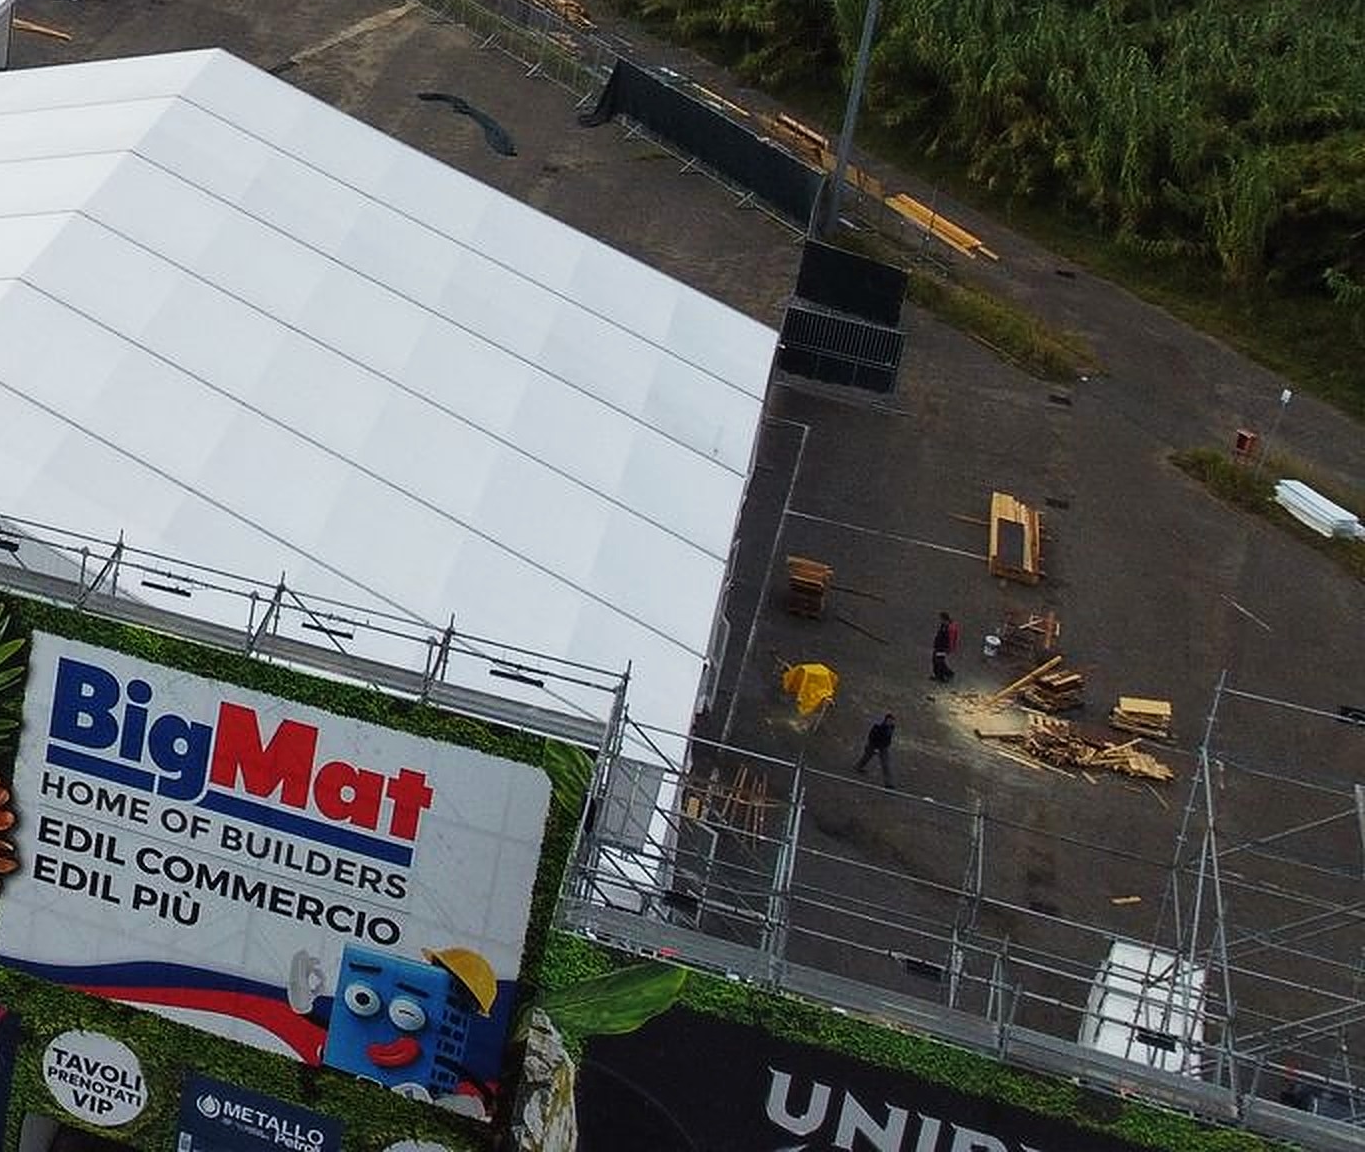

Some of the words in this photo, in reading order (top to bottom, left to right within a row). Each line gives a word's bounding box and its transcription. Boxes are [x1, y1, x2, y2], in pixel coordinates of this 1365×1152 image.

[46, 656, 434, 841] BigMat
[40, 771, 149, 825] HOME
[161, 808, 210, 840] OF
[221, 826, 408, 901] BUILDERS
[33, 852, 121, 905] EDIL
[132, 882, 202, 927] PIÙ
[37, 815, 126, 866] EDIL
[135, 844, 402, 946] COMMERCIO
[46, 1067, 142, 1109] PRENOTATI
[51, 1047, 142, 1091] TAVOLI
[71, 1091, 115, 1116] VIP
[222, 1099, 325, 1145] METALLO
[766, 1065, 1045, 1152] UNI
